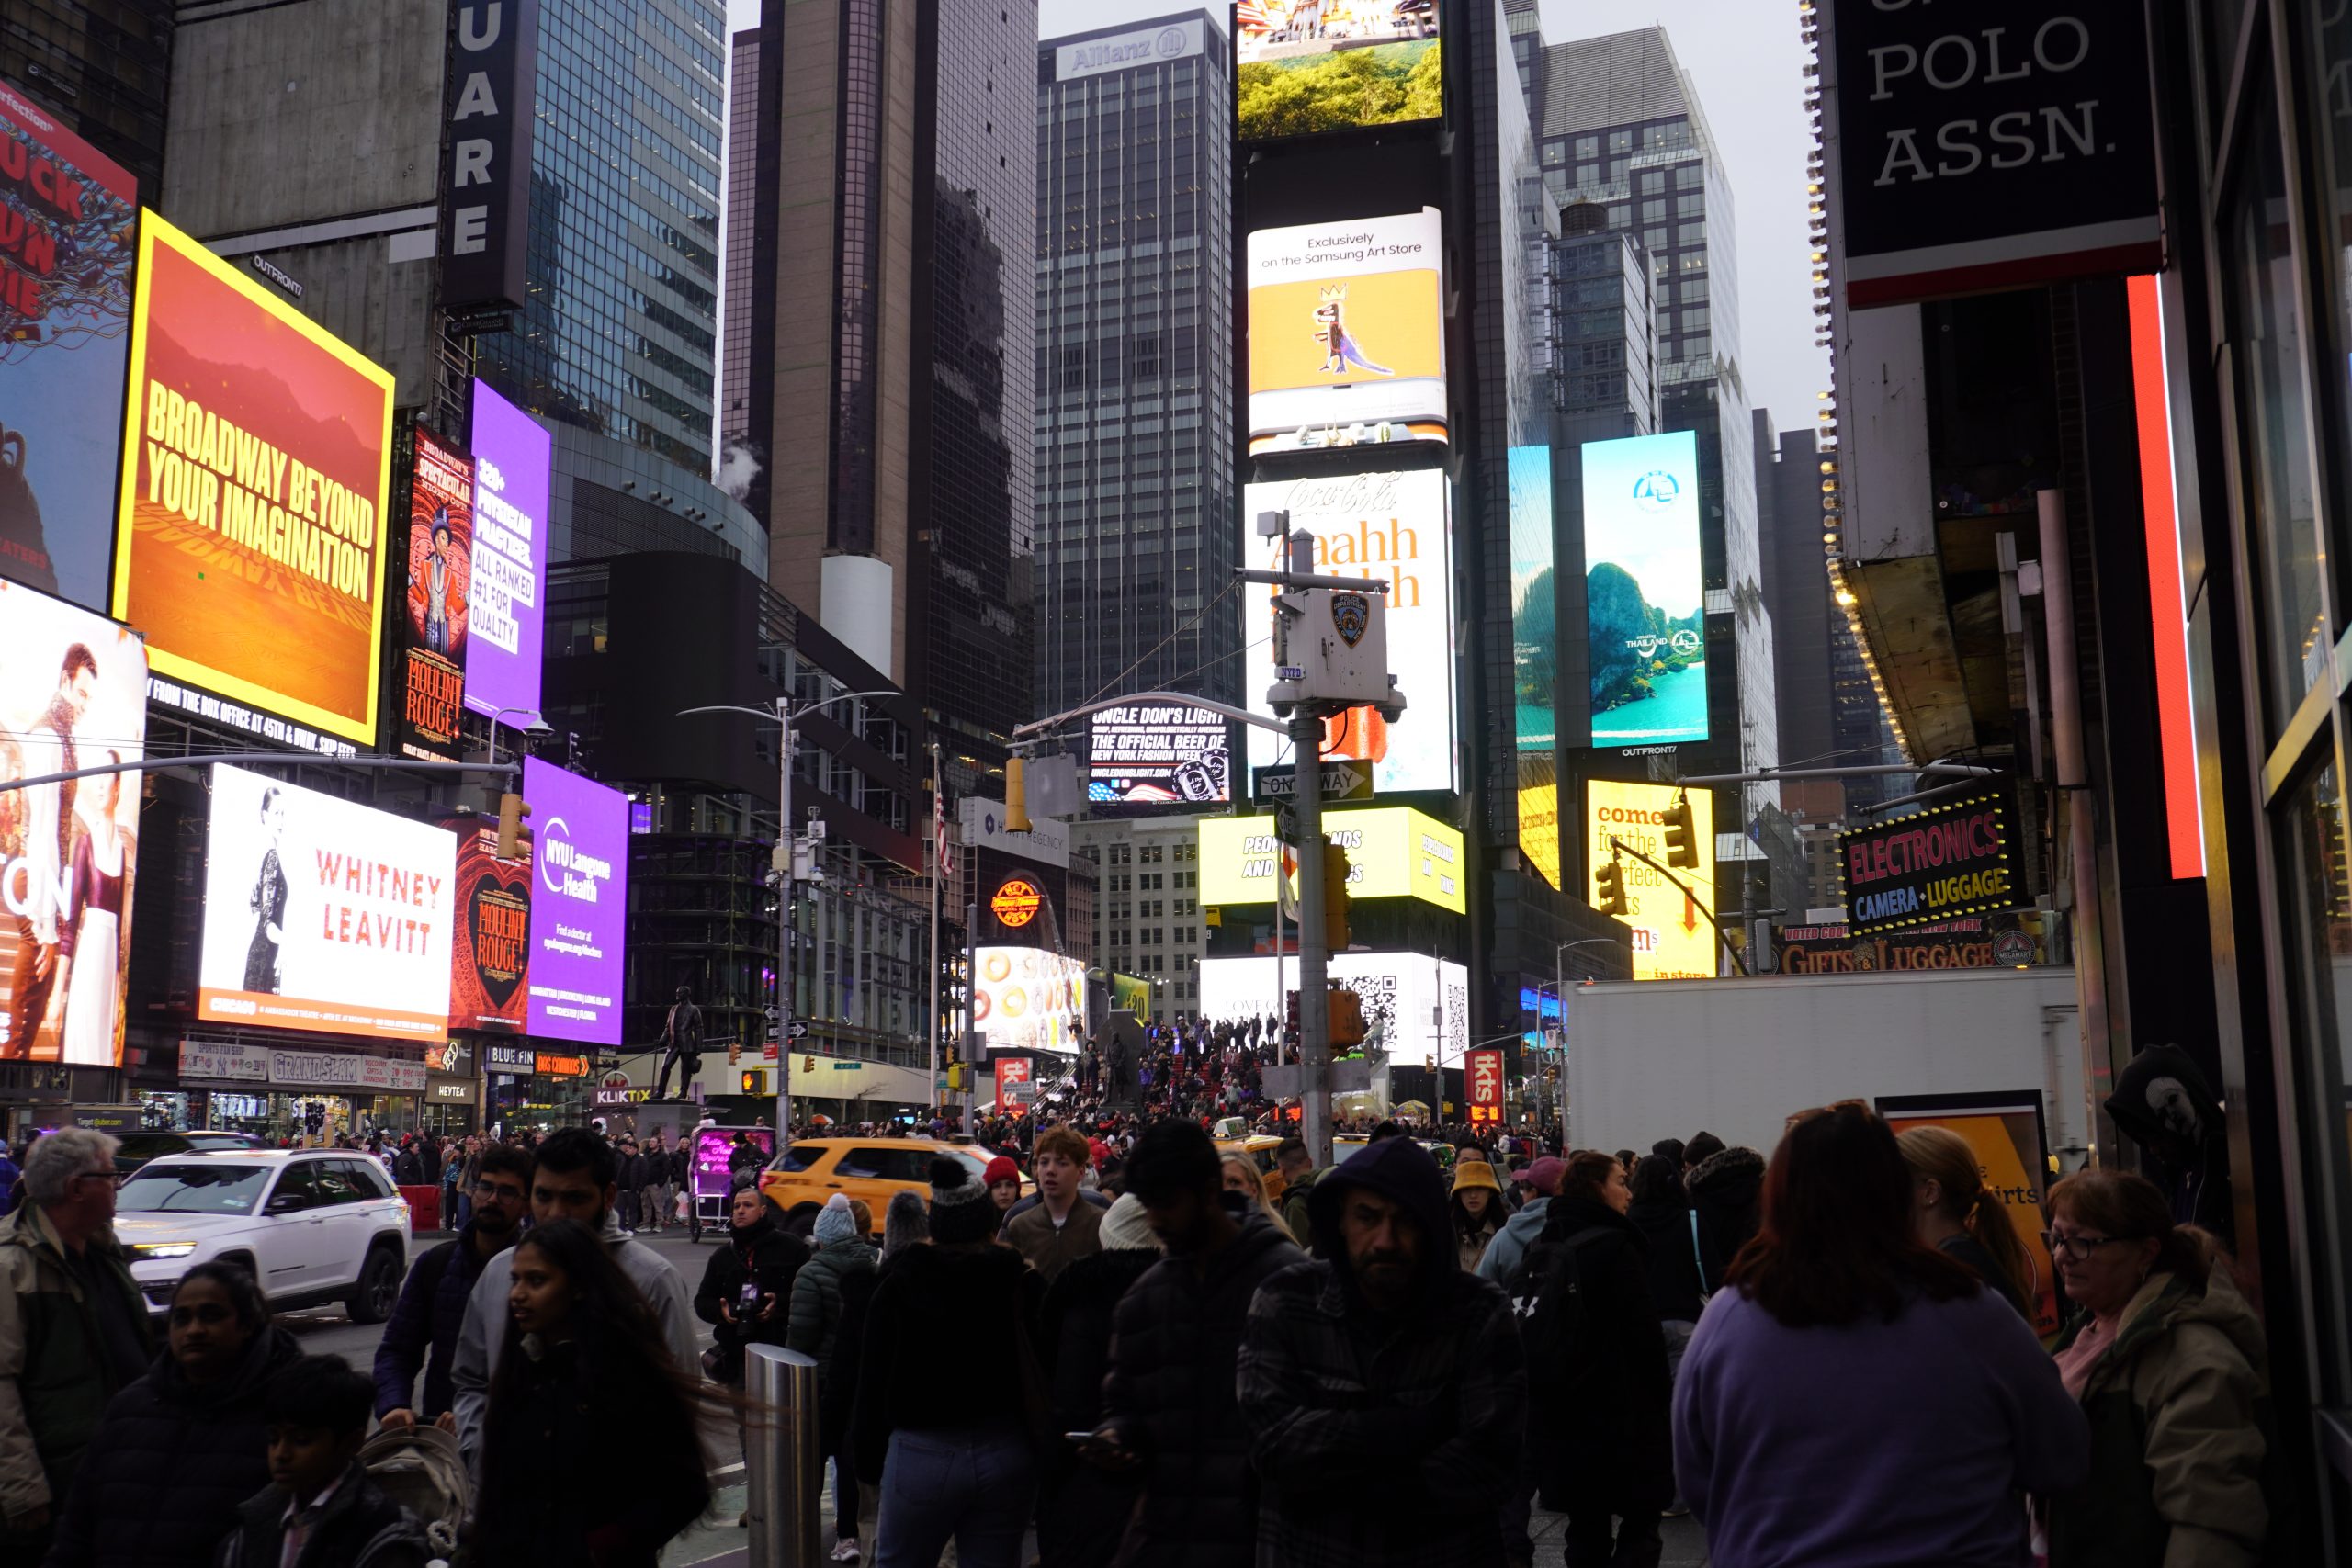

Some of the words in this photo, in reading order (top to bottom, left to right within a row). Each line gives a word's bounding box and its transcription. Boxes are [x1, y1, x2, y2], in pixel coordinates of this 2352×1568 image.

[1072, 39, 1150, 71] Allianz
[1868, 17, 2089, 101] POLO
[1874, 100, 2115, 186] ASSN.
[1308, 232, 1374, 249] Exclusively
[1261, 258, 1277, 268] on
[1282, 254, 1301, 266] the
[1305, 248, 1363, 263] Samsung
[1367, 245, 1385, 257] Art
[1389, 243, 1422, 254] Store
[147, 378, 288, 503] BROADWAY
[288, 457, 374, 549] BEYOND
[424, 439, 469, 476] BROADWAY'S
[419, 458, 470, 504] SPECTACULAR
[422, 479, 449, 501] NIGHT
[147, 441, 218, 531] YOUR
[221, 479, 369, 603] IMAGINATION
[477, 485, 532, 541] PHYSICIAN
[475, 549, 492, 578] ALL
[496, 559, 532, 599] RANKED
[474, 578, 488, 604] #1
[492, 586, 509, 615] FOR
[1333, 602, 1366, 612] DEPARTMENT
[472, 606, 516, 646] QUALITY.
[1625, 637, 1668, 649] THAILAND
[408, 657, 455, 704] MOULIN
[1282, 668, 1301, 678] NYPD
[154, 679, 181, 706] FROM
[183, 689, 200, 714] THE
[200, 695, 220, 719] BOX
[220, 704, 251, 730] OFFICE
[251, 713, 263, 734] AT
[263, 717, 286, 741] 45TH
[286, 725, 293, 744] &
[1092, 708, 1138, 724] UNCLE
[1092, 735, 1116, 749] THE
[1117, 735, 1171, 749] OFFICIAL
[1173, 735, 1206, 749] BEER
[1207, 735, 1226, 749] OF
[1091, 750, 1113, 761] NEW
[1114, 750, 1136, 761] YORK
[1137, 750, 1175, 761] FASHION
[1176, 750, 1201, 761] WEEK
[1091, 769, 1171, 778] UNCLEDONSLIGHT.COM
[1270, 778, 1295, 793] ON
[1321, 773, 1353, 790] WAY
[1598, 807, 1664, 825] come
[1626, 828, 1656, 853] the
[1849, 812, 2000, 885] ELECTRONICS
[546, 838, 569, 867] NYU
[569, 845, 611, 880] Langone
[1242, 860, 1274, 878] AND
[316, 847, 441, 909] WHITNEY
[1599, 860, 1662, 886] rfect
[563, 873, 597, 903] Health
[1005, 884, 1026, 895] HOT
[1855, 886, 1920, 921] CAMERA
[1927, 867, 2007, 908] LUGGAGE
[323, 904, 431, 955] LEAVITT
[479, 902, 519, 939] MOULIN
[1005, 913, 1028, 923] NOW
[1785, 927, 1818, 941] VOTED
[1951, 919, 1983, 931] YORK
[1781, 944, 1852, 974] GIFTS
[1862, 958, 1871, 970] &
[1875, 939, 1995, 970] LUGGAGE
[1655, 968, 1668, 978] in
[1671, 970, 1707, 978] store
[1225, 999, 1258, 1012] LOVE
[198, 1043, 219, 1055] SPORTS
[220, 1044, 230, 1055] FAN
[232, 1045, 244, 1055] SHOP
[492, 1047, 515, 1063] BLUE
[518, 1051, 533, 1064] FIN
[537, 1056, 550, 1073] DOS
[551, 1056, 580, 1075] CAMINOS
[1475, 1054, 1497, 1102] tkts
[597, 1090, 650, 1103] KLIKTIX
[1004, 1062, 1024, 1106] tks
[217, 1097, 266, 1117] GRAND
